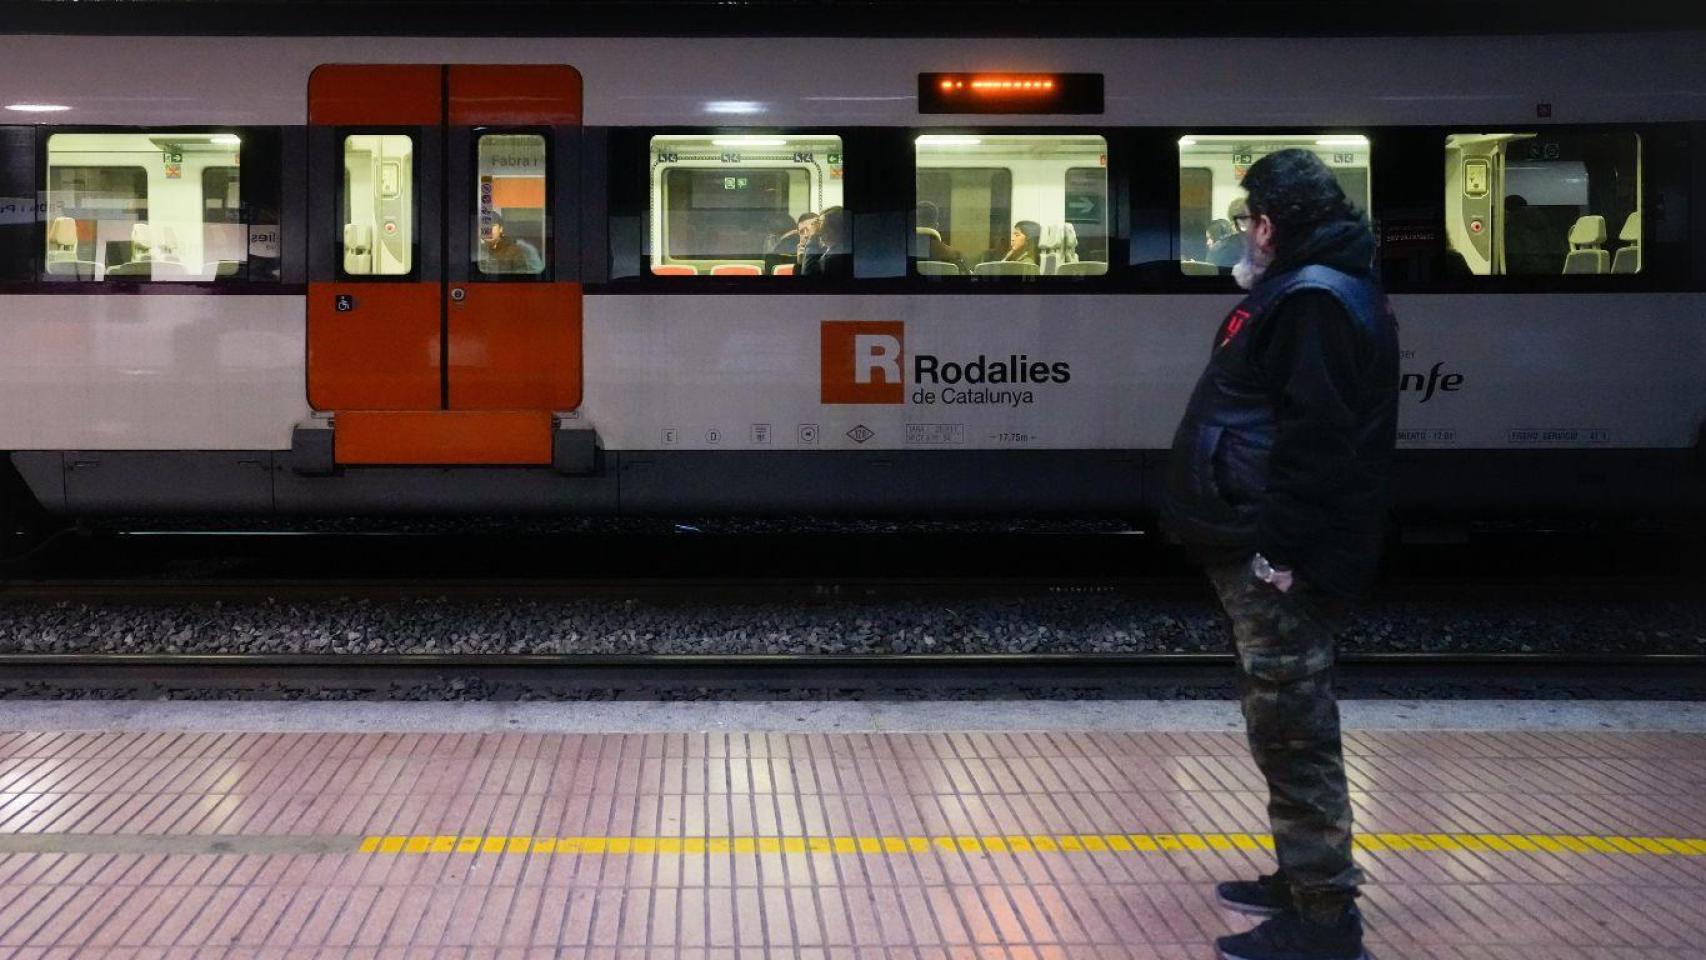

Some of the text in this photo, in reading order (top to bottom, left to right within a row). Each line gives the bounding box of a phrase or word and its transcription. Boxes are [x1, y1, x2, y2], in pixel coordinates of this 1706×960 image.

[491, 154, 530, 167] Fabra
[855, 334, 902, 384] R
[914, 355, 1070, 384] Rodalies
[912, 388, 1034, 408] de Catalunya
